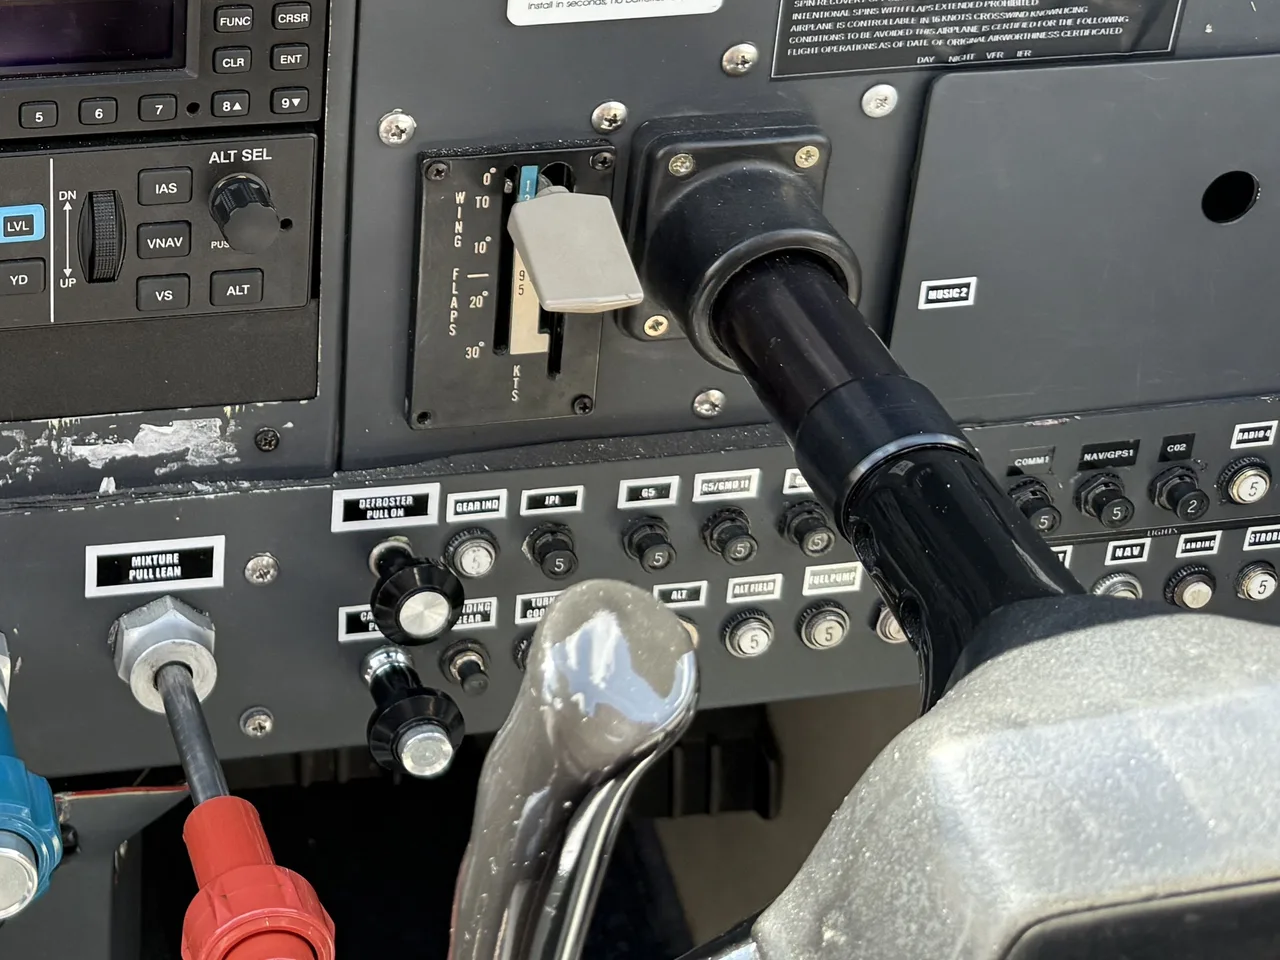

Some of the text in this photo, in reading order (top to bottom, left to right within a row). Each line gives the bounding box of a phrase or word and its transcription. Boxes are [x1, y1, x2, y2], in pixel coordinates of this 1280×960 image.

[528, 0, 553, 10] Install
[556, 0, 563, 8] in
[220, 16, 251, 27] FUNC
[278, 13, 308, 23] CRSR
[209, 148, 272, 164] ALT SEL
[156, 183, 177, 194] IAS
[475, 196, 489, 208] TO
[7, 221, 30, 232] LVL
[148, 238, 183, 248] VNAV
[226, 284, 250, 296] ALT
[1084, 449, 1134, 461] NAV/GPS1
[359, 496, 413, 510] DEFROSTER
[456, 499, 499, 512] GEAR IND
[1115, 545, 1140, 558] NAV
[1182, 540, 1215, 551] LANDING
[131, 554, 179, 567] MIXTURE
[129, 566, 181, 579] PULL LEAN
